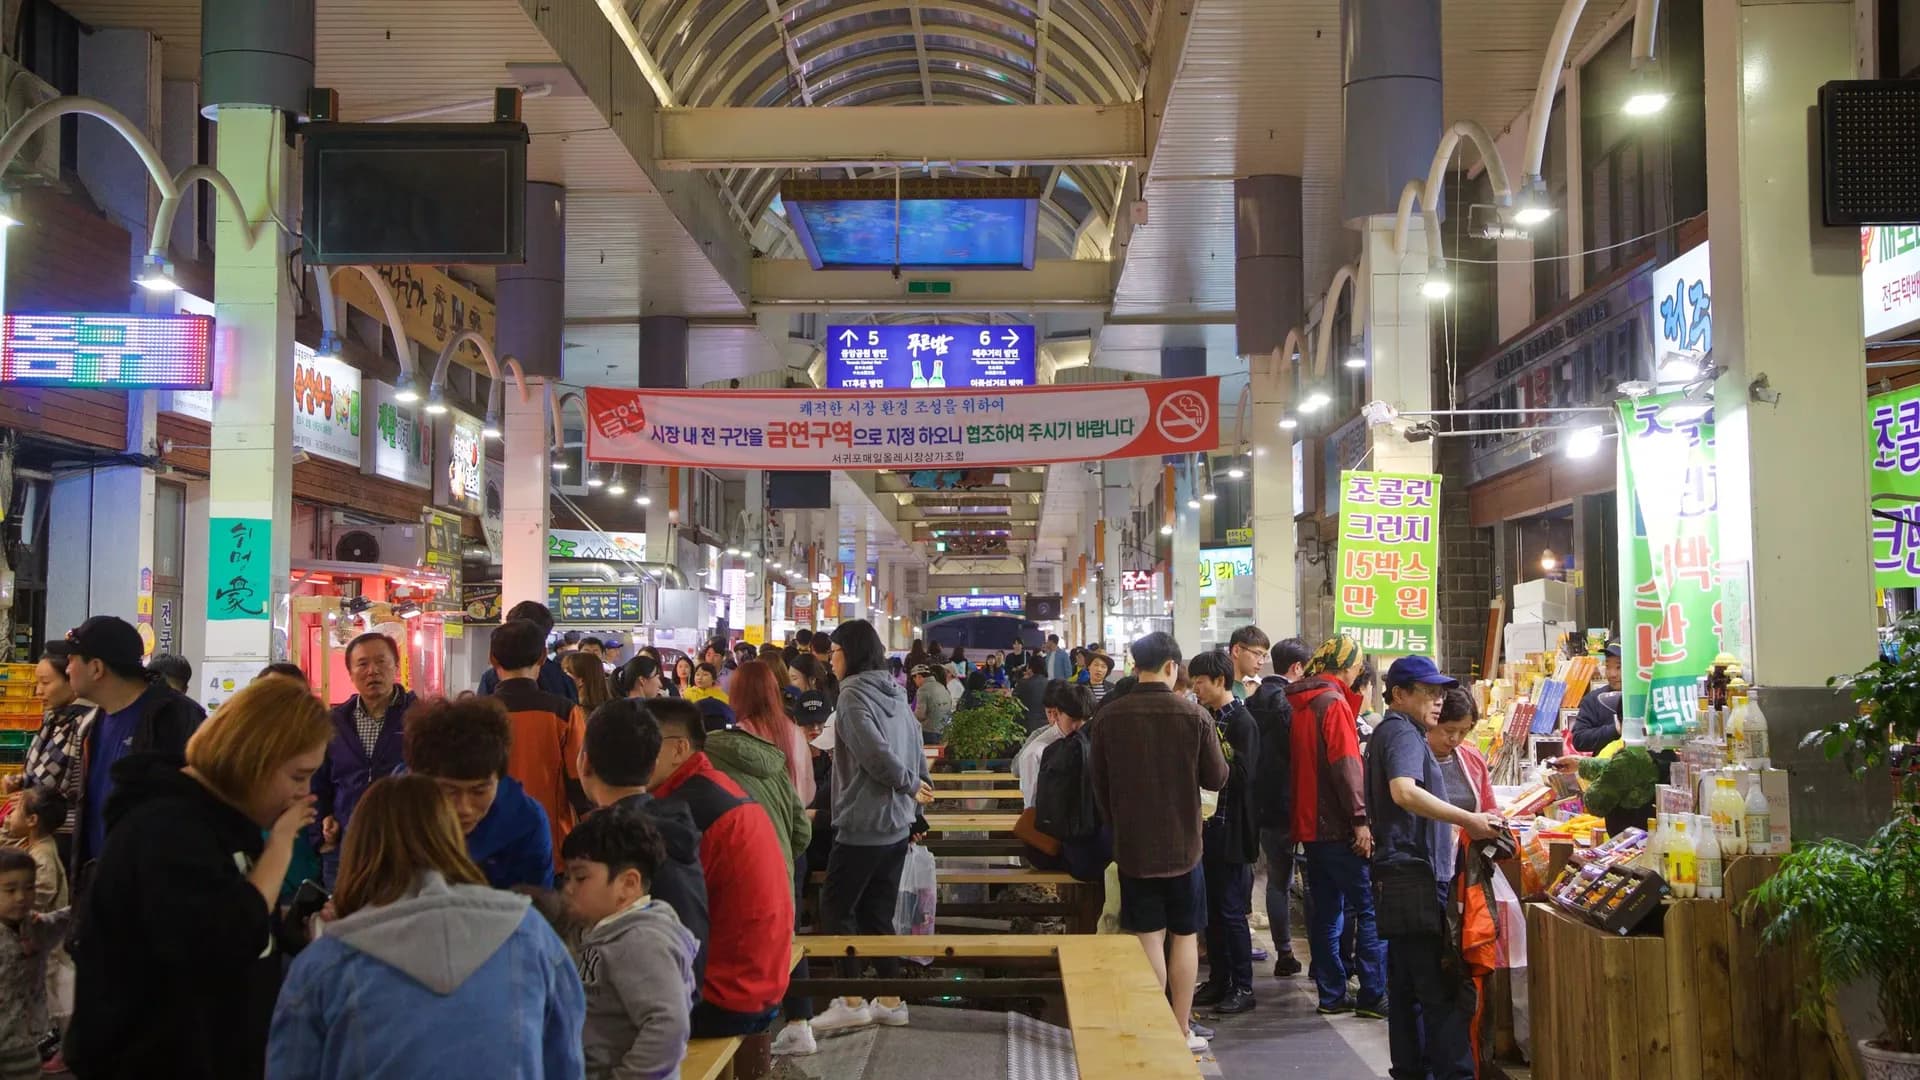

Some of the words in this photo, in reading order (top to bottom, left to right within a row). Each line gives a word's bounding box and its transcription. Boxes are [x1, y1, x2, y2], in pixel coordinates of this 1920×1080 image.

[868, 330, 880, 346] 5
[979, 330, 991, 346] 6
[598, 398, 644, 438] 금연
[847, 400, 877, 416] 시장
[880, 399, 909, 416] 환경
[914, 398, 958, 415] 조성을
[962, 397, 1005, 414] 위하여
[701, 426, 716, 446] 전
[719, 427, 764, 447] 구간을
[886, 426, 916, 446] 지정
[918, 425, 963, 445] 하오니
[966, 420, 1025, 445] 협조하여
[1028, 419, 1072, 442] 주시기
[1075, 418, 1136, 440] 바랍니다
[1347, 477, 1433, 507] 초콜릿
[1345, 513, 1431, 543] 크런치
[1345, 550, 1430, 583] 15박스
[1343, 586, 1378, 616] 만
[1397, 586, 1428, 618] 원
[1340, 626, 1429, 652] 택배가능
[209, 677, 220, 691] 4
